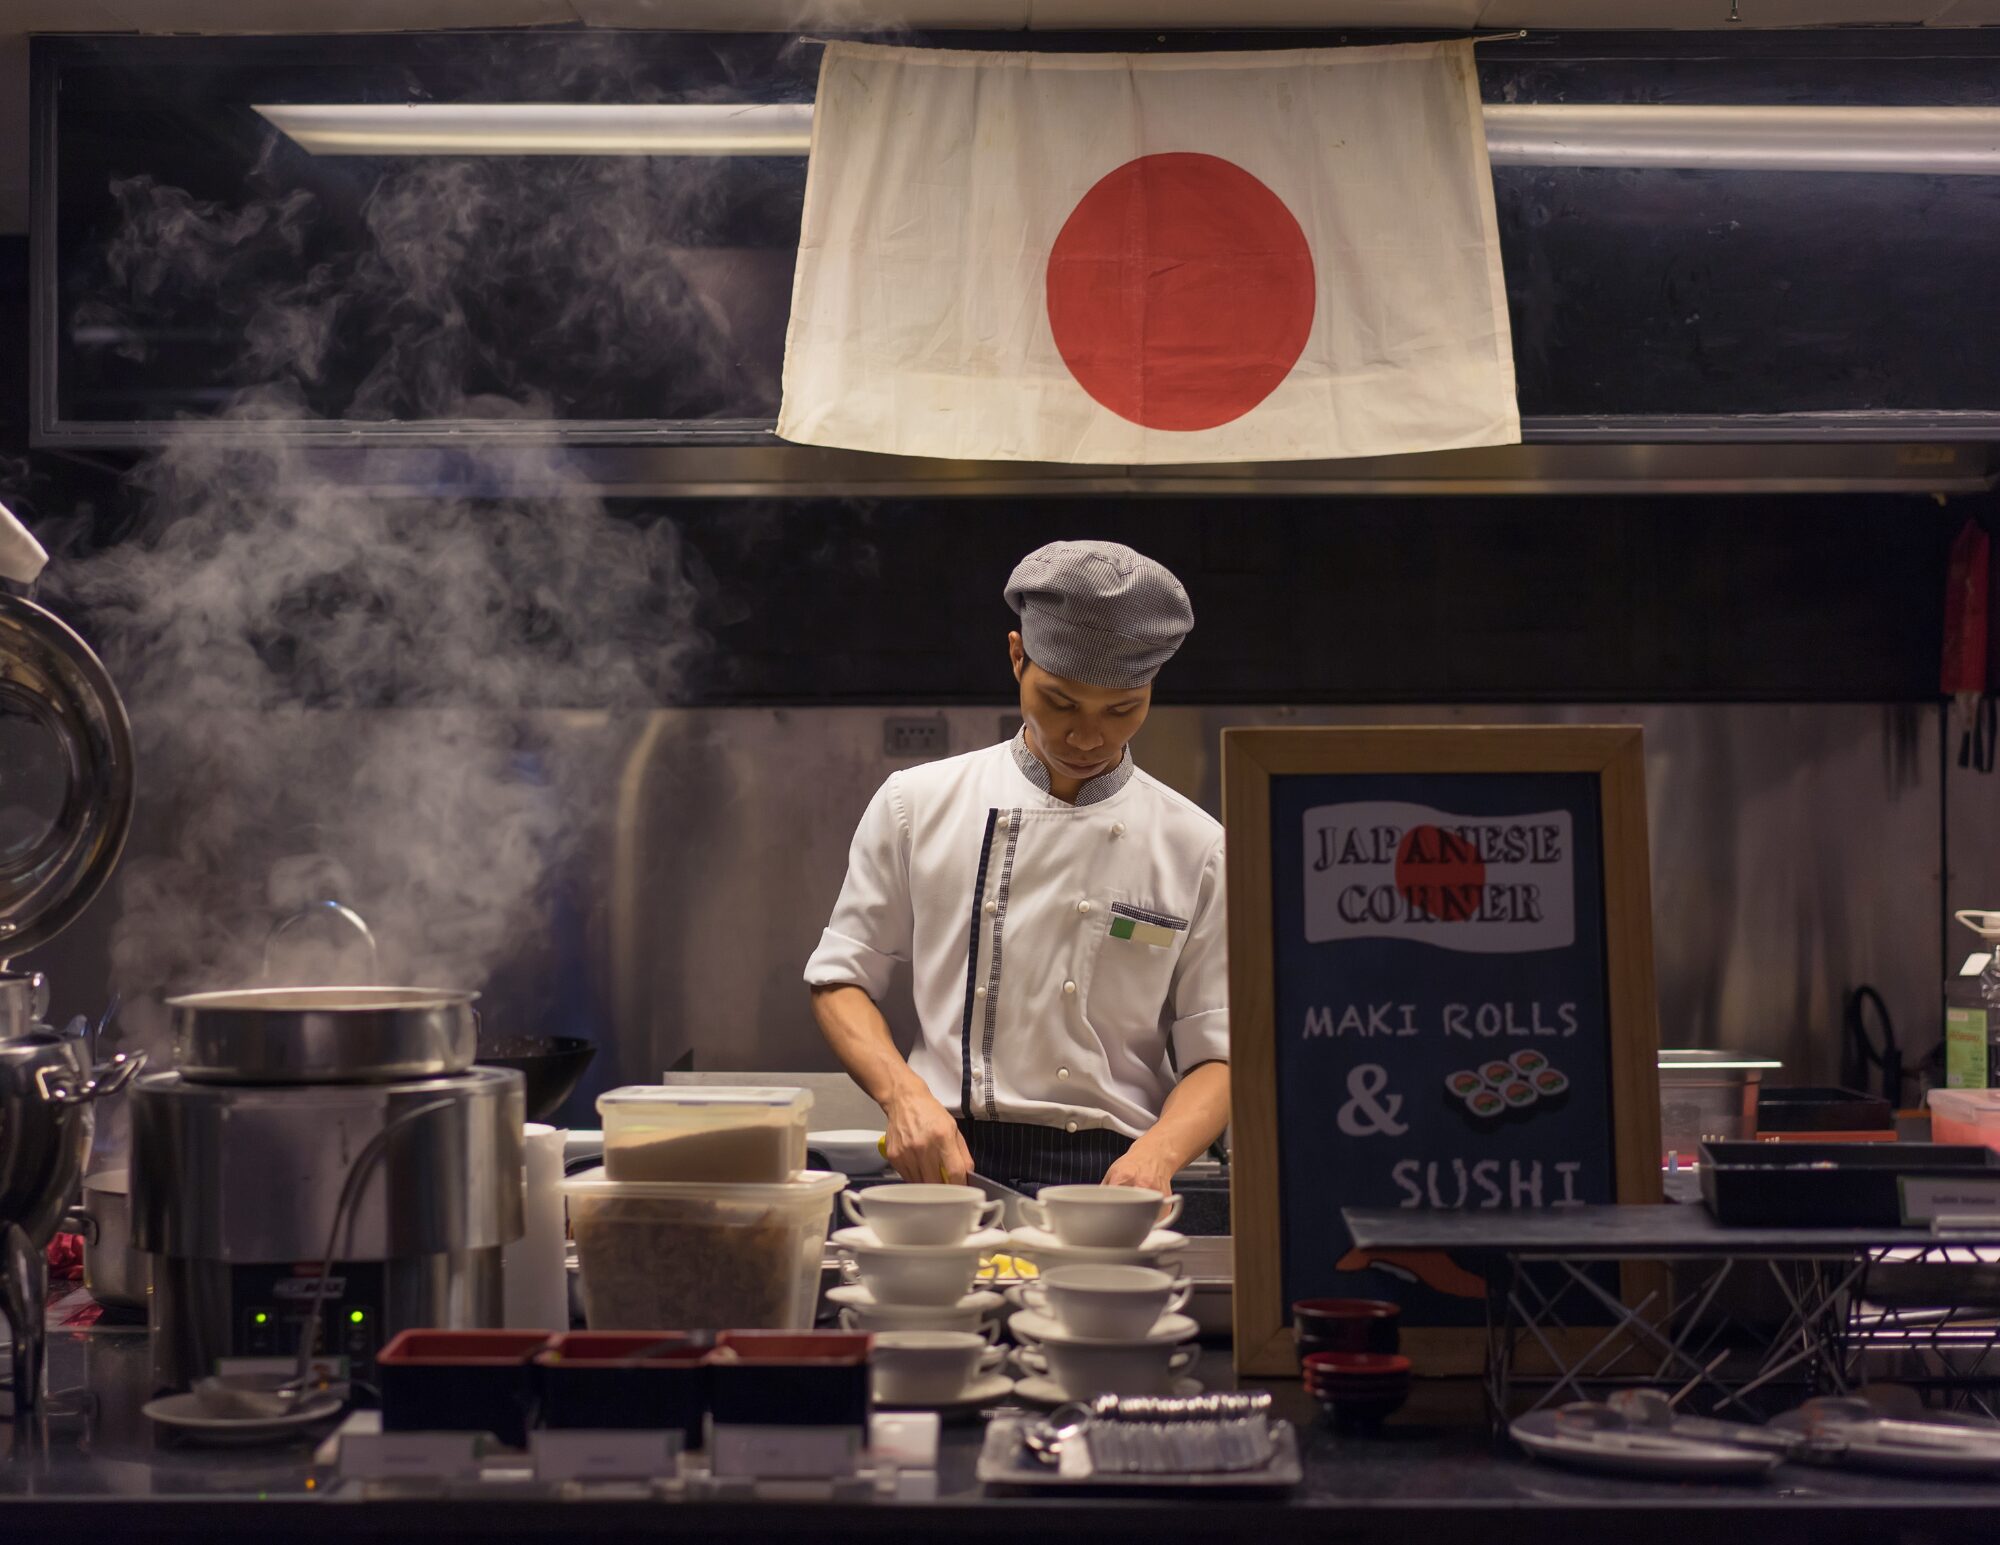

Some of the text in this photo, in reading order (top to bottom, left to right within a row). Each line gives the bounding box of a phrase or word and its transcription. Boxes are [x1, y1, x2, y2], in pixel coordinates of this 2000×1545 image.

[1313, 824, 1560, 872] JAPANESE
[1336, 883, 1544, 924] CORNER
[1303, 1001, 1578, 1039] MAKI ROLLS
[1336, 1063, 1409, 1136] &
[1391, 1157, 1585, 1208] SUSHI
